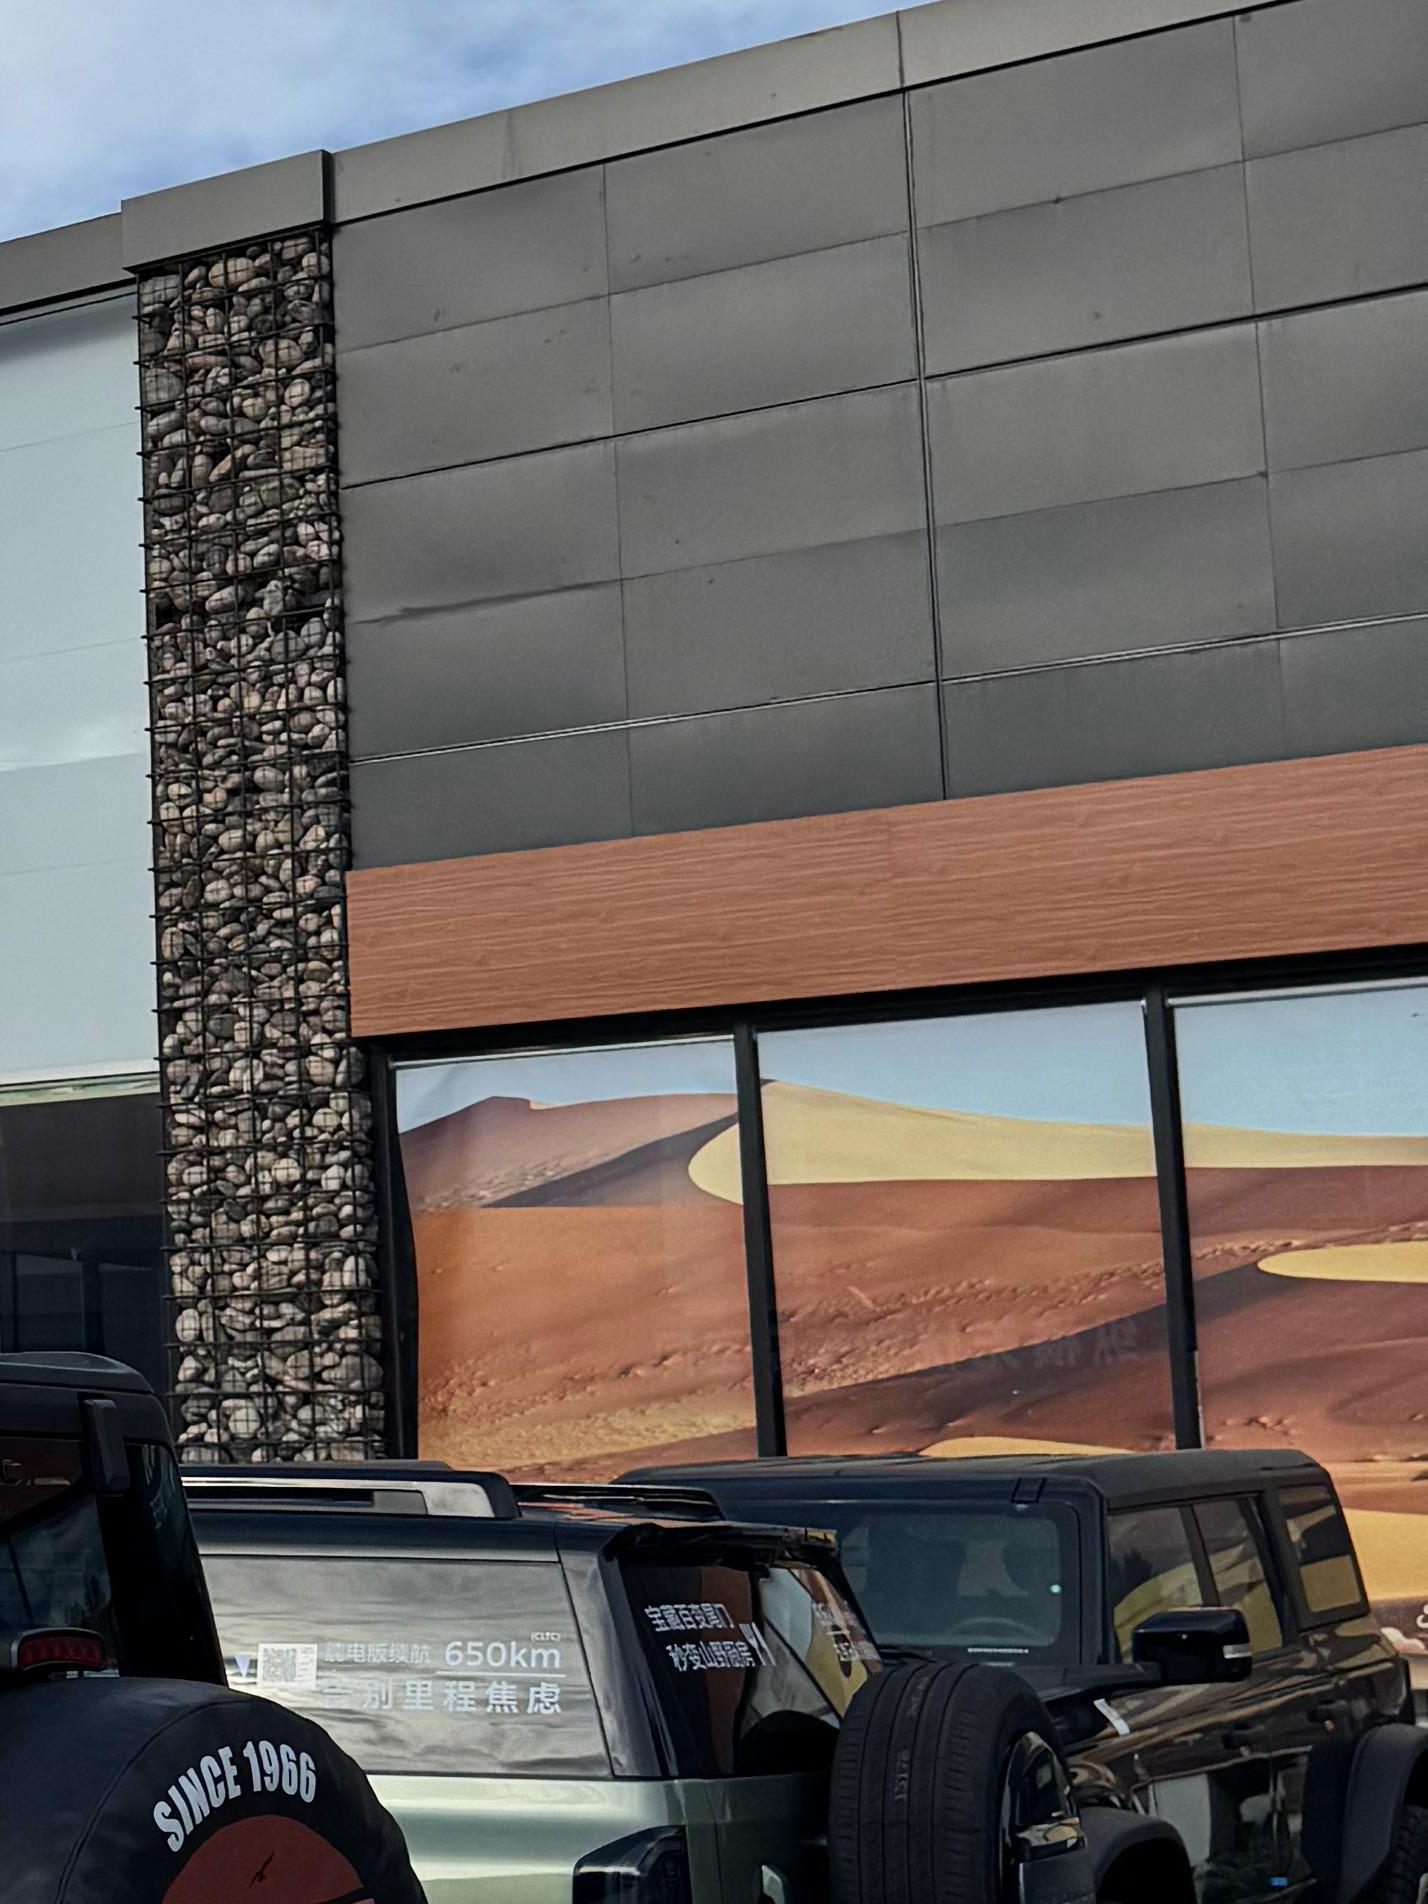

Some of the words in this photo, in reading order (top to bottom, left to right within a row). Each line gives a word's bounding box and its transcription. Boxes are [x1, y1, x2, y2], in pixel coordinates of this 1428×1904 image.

[444, 1640, 562, 1669] 650km
[153, 1746, 241, 1852] SINCE
[243, 1740, 317, 1803] 1966
